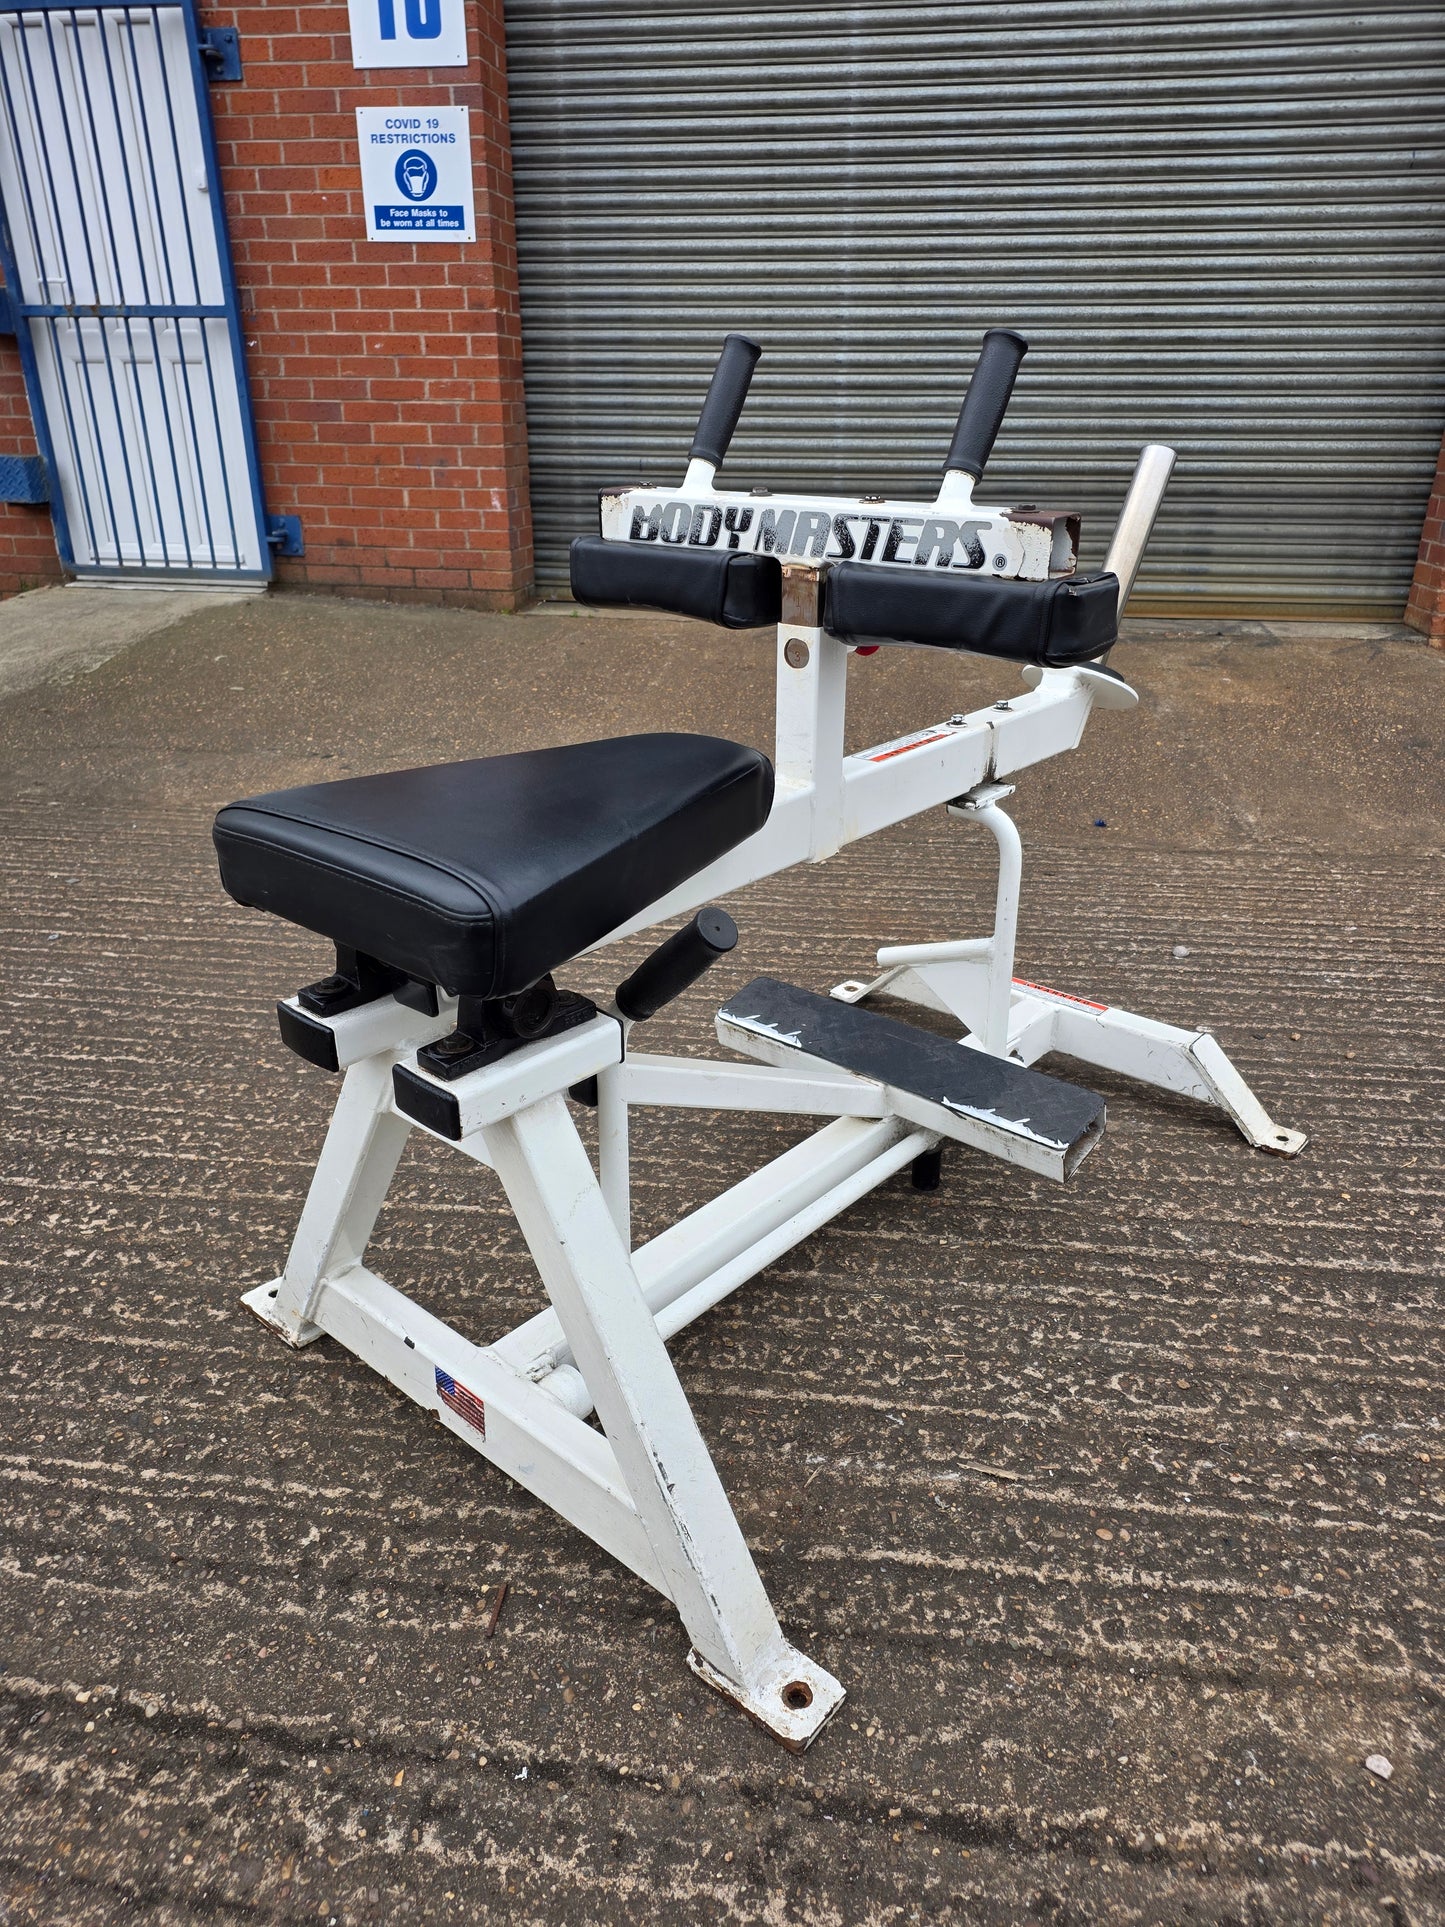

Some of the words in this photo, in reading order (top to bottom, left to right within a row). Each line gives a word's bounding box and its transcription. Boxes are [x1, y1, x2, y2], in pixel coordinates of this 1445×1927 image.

[385, 118, 421, 129] COVID
[426, 118, 439, 129] 19
[370, 133, 456, 144] RESTRICTIONS
[389, 208, 409, 217] Face
[411, 208, 437, 217] Masks
[439, 209, 448, 217] to
[380, 219, 391, 227] be
[414, 219, 424, 227] at
[425, 219, 436, 227] all
[437, 219, 460, 227] times
